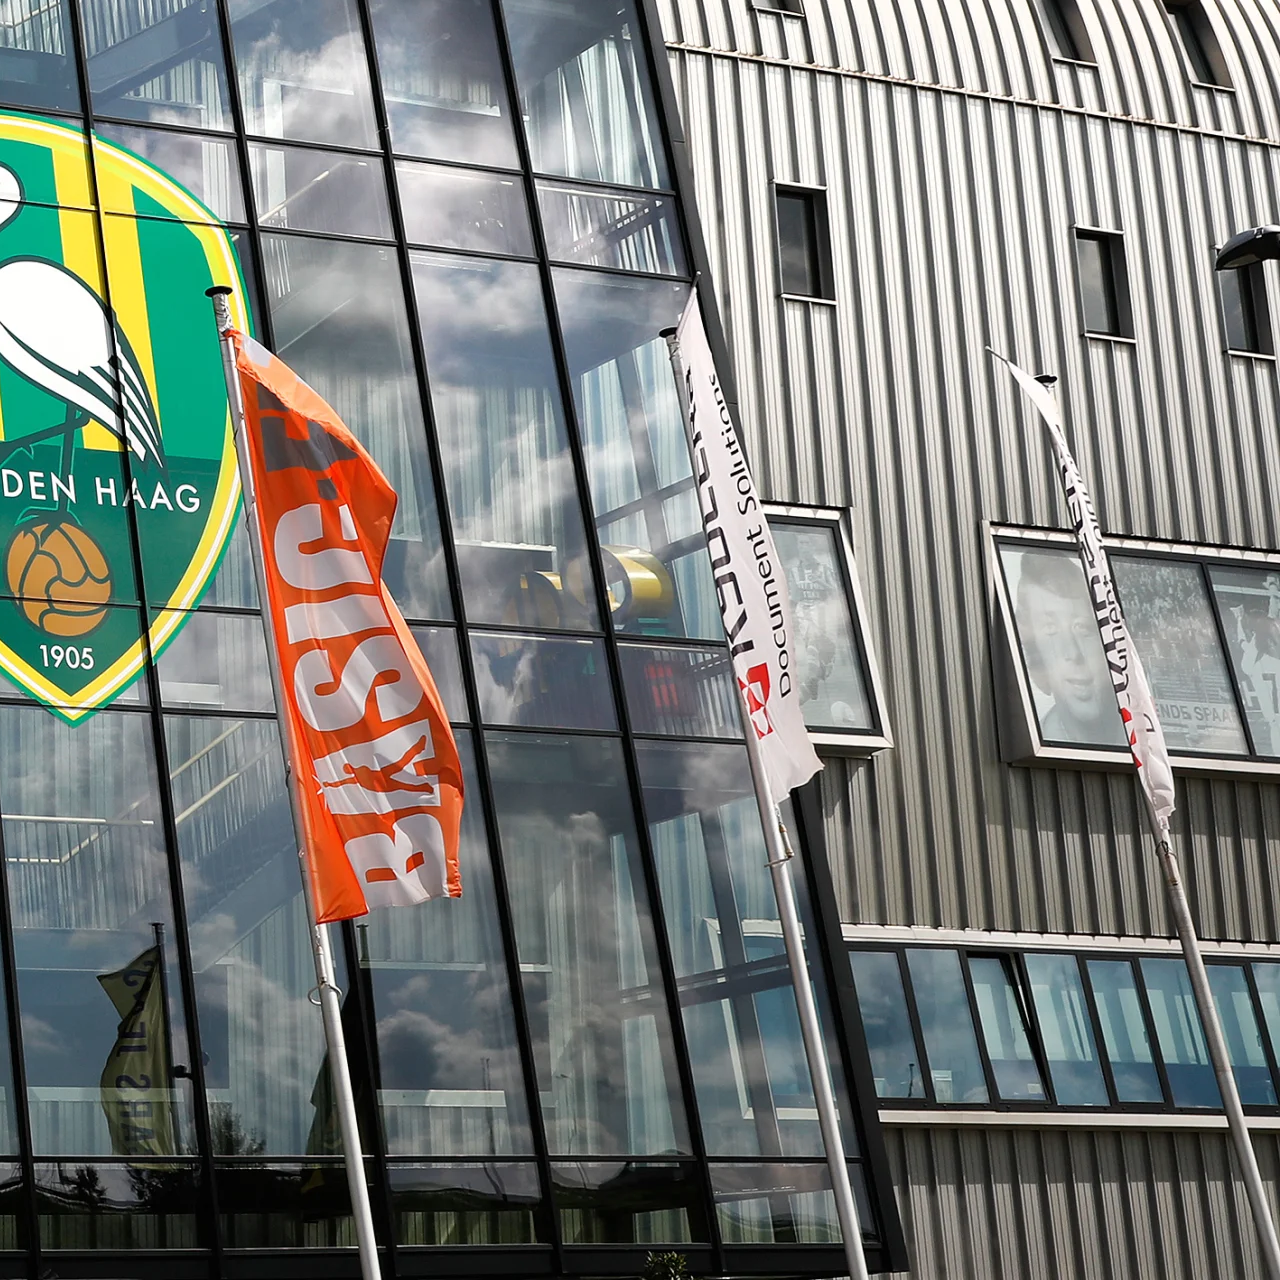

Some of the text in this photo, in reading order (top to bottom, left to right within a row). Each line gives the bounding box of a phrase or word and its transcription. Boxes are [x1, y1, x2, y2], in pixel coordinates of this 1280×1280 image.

[1, 468, 77, 504] DEN
[95, 476, 201, 513] HAAG
[708, 373, 792, 698] Document Solutions
[39, 644, 95, 671] 1905
